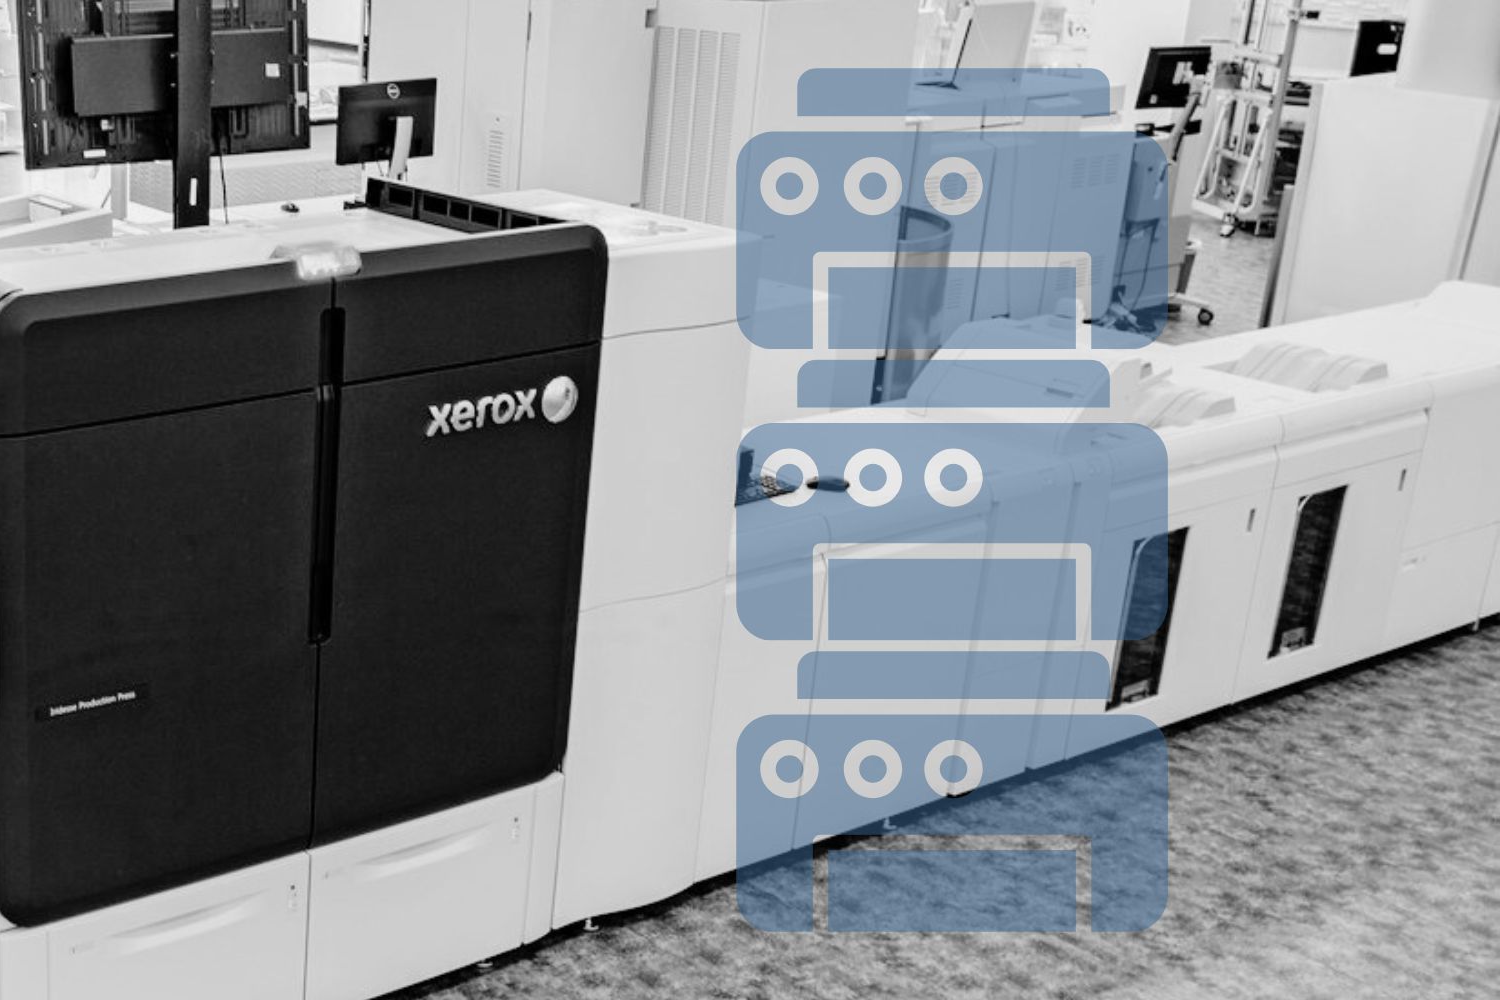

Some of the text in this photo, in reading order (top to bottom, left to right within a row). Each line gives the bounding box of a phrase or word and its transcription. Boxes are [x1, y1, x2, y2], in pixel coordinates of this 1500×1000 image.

[425, 388, 537, 437] xerox
[78, 697, 117, 710] Production
[117, 691, 135, 701] Press
